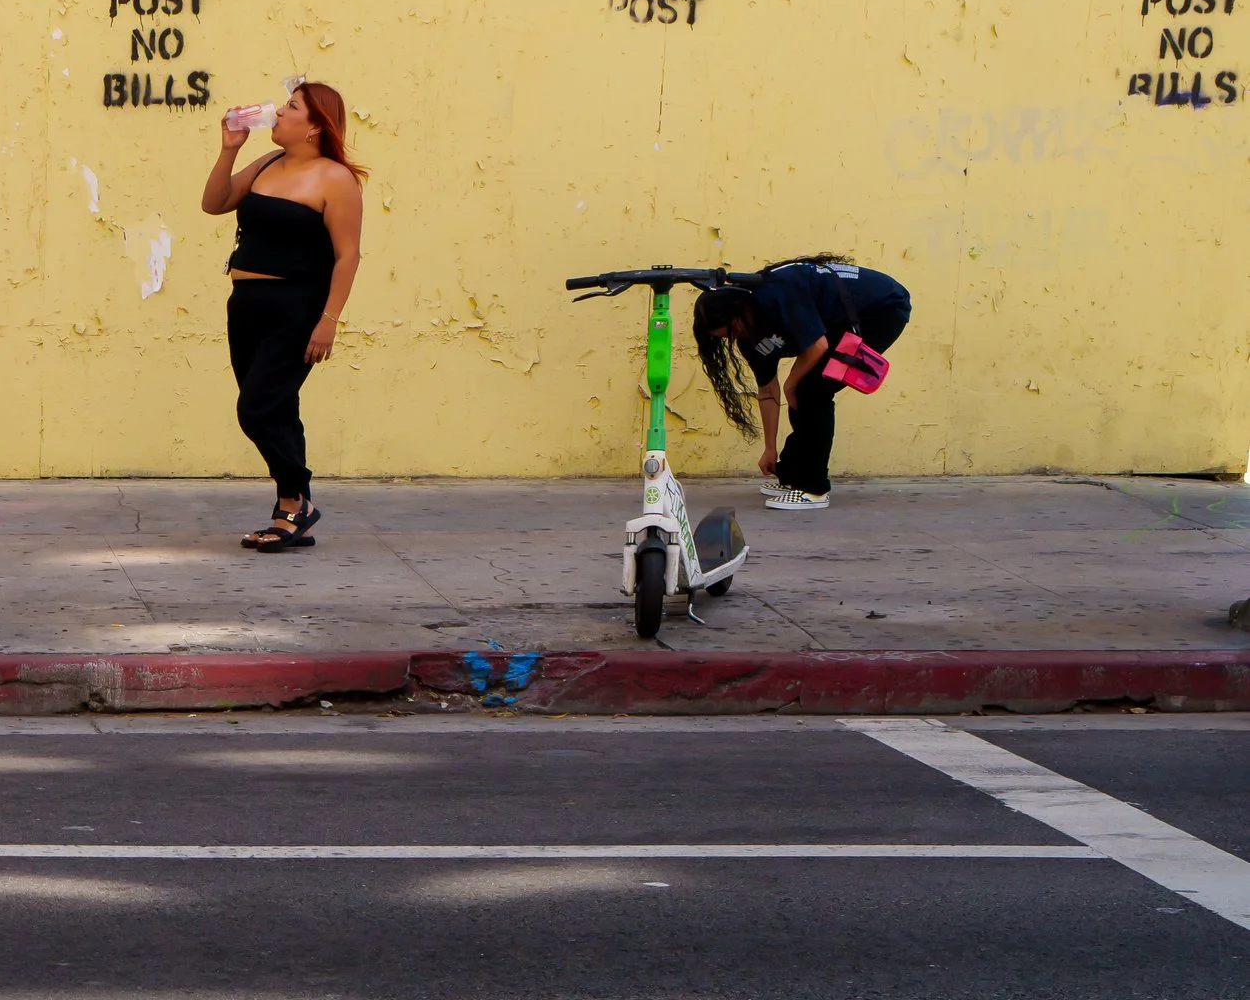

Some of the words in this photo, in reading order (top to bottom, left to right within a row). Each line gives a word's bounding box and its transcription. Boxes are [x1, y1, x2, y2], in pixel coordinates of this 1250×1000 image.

[131, 28, 184, 61] NO
[1159, 26, 1213, 59] NO
[103, 71, 210, 108] BILLS
[1128, 71, 1237, 107] BILLS
